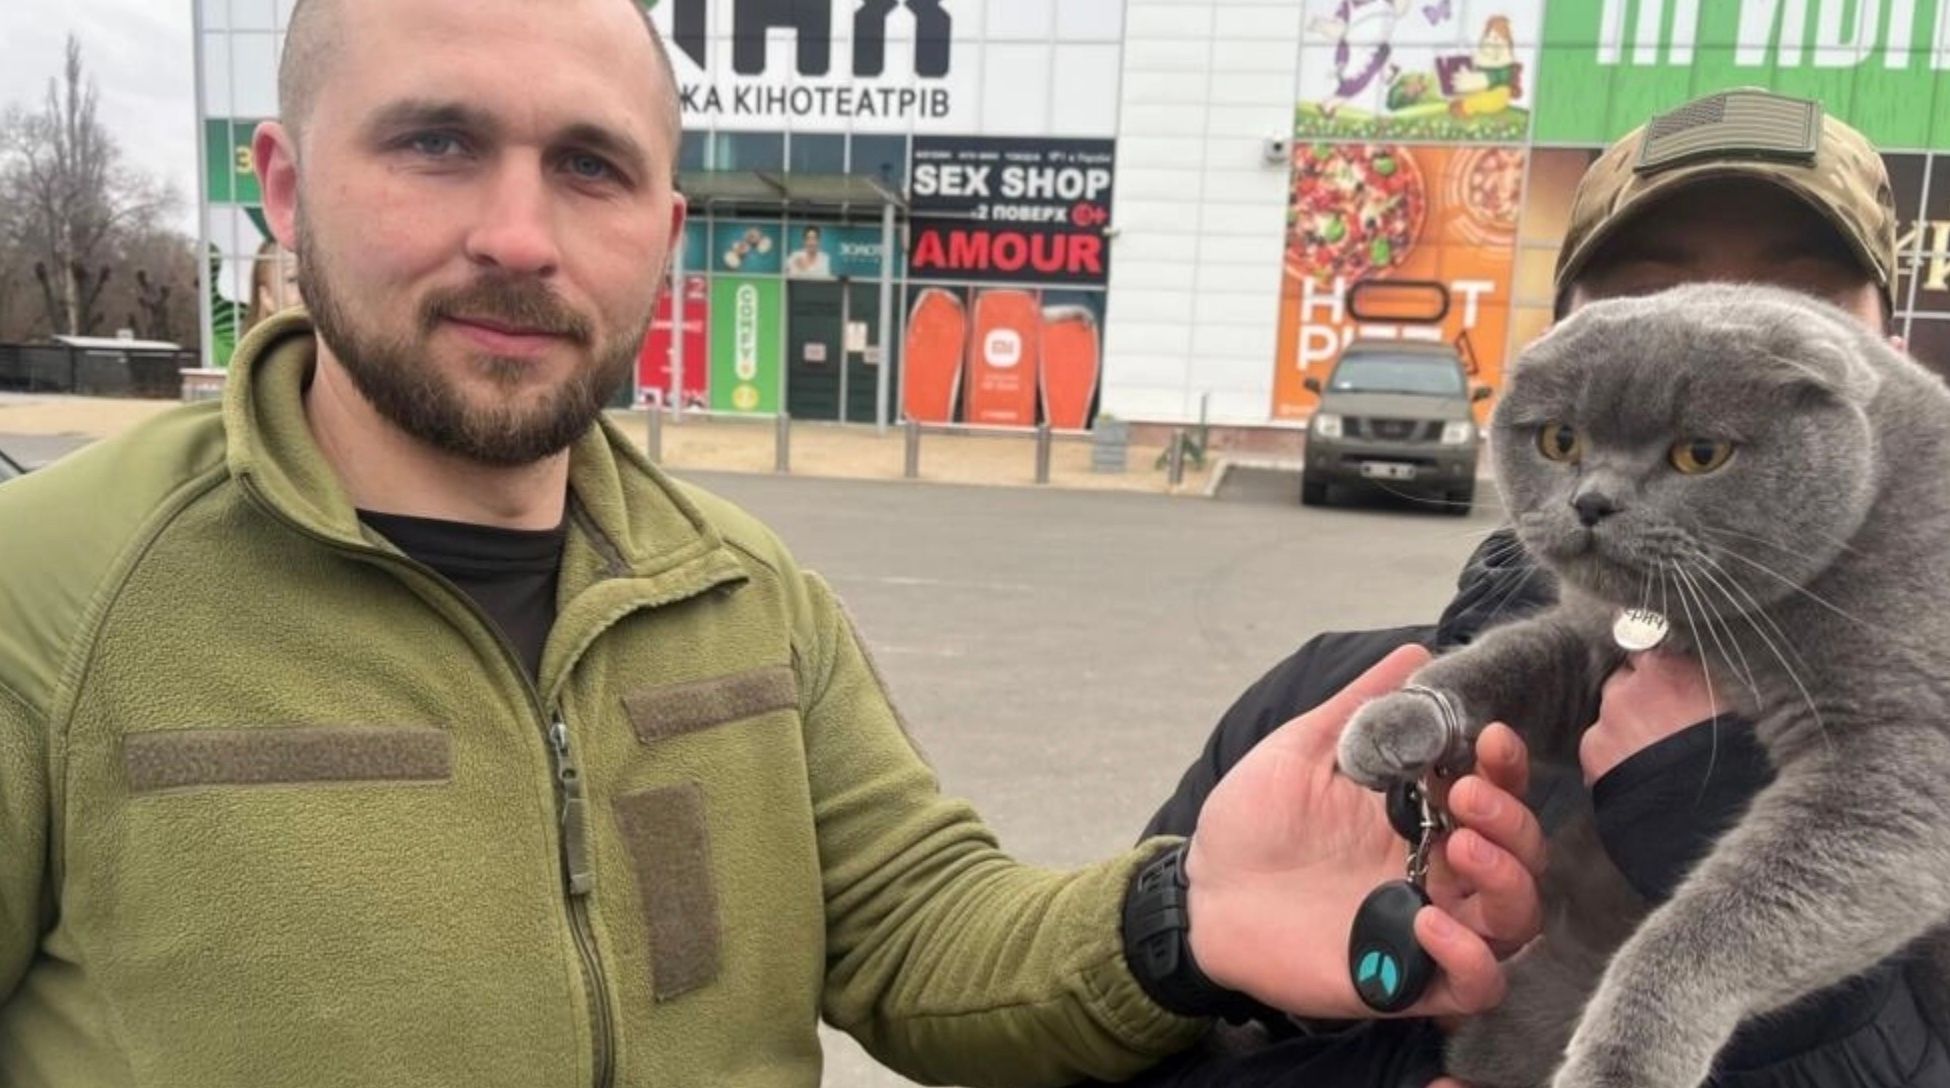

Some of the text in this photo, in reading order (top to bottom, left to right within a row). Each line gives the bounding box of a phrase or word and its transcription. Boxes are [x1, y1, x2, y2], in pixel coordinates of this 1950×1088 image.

[734, 85, 950, 118] КІНОТЕАТРІВ
[913, 164, 1111, 200] SEX SHOP
[992, 205, 1068, 223] ПОВЕРХ
[912, 229, 1102, 273] AMOUR
